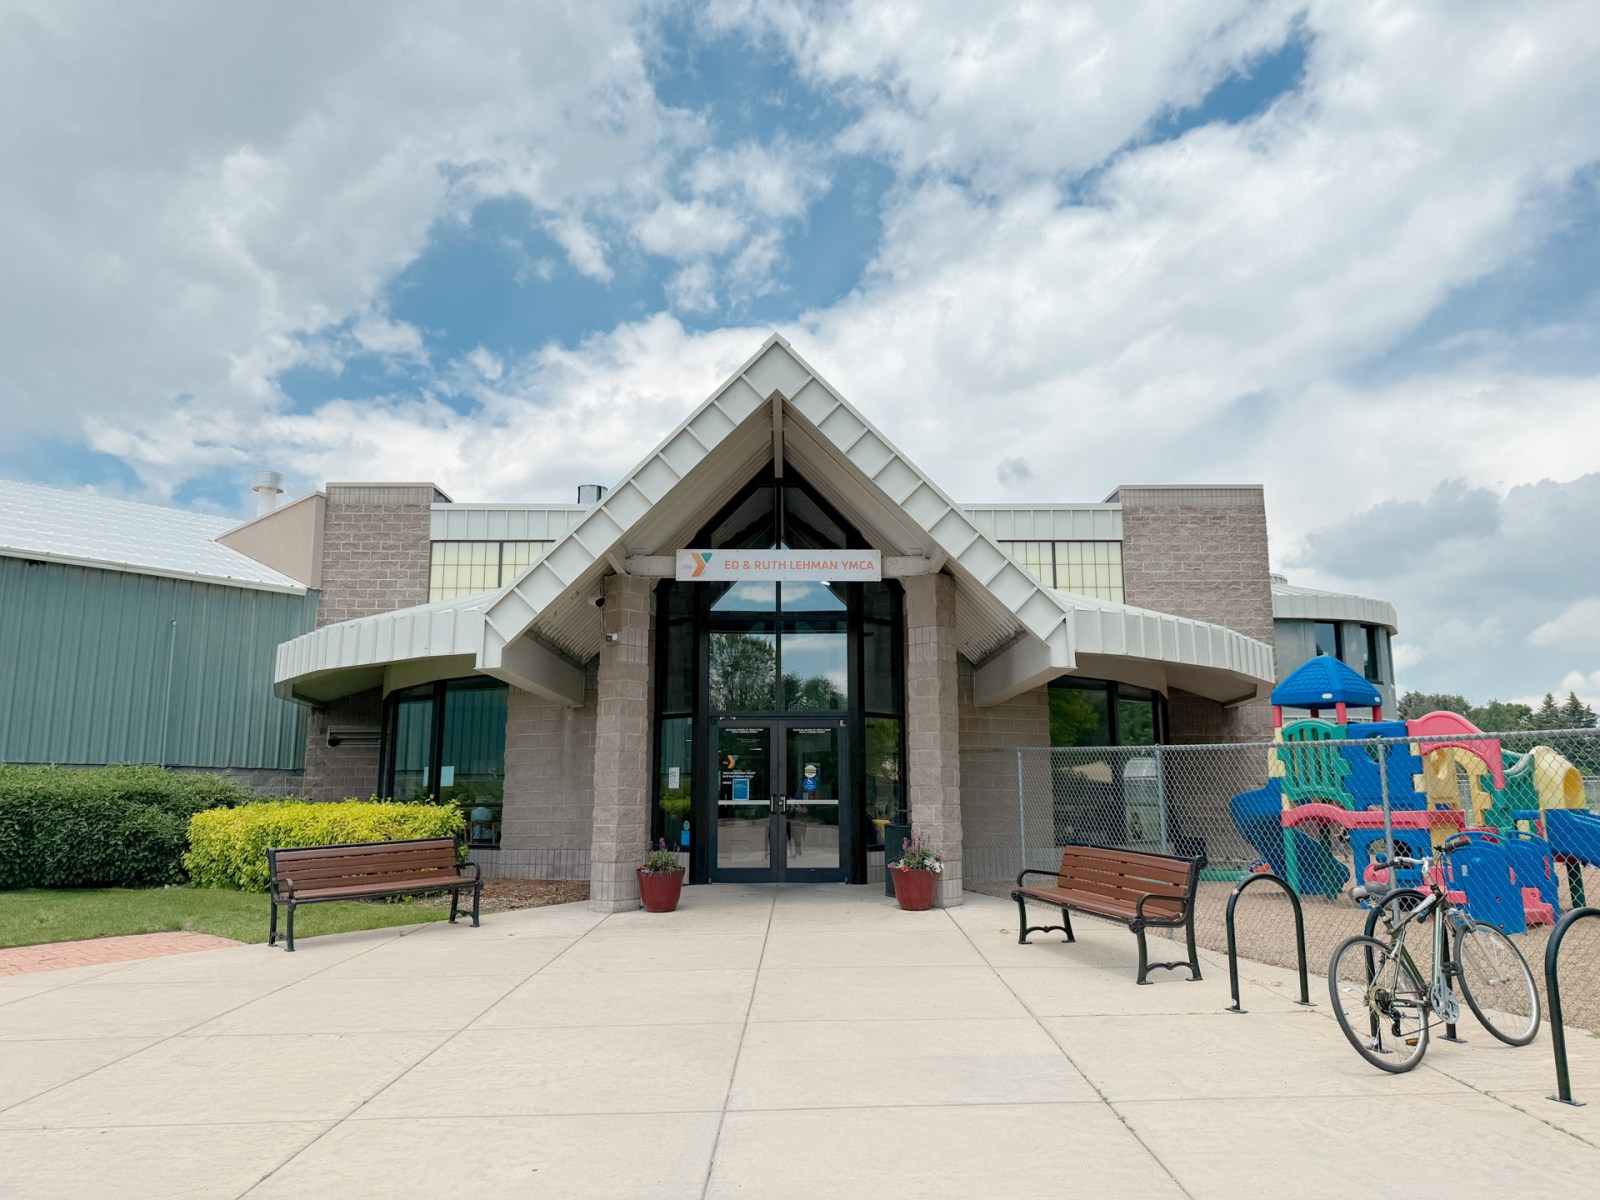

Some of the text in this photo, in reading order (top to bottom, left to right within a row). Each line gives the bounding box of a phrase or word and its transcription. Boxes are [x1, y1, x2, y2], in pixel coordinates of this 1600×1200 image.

[724, 560, 874, 570] ED & RUTH LEHMAN YMCA
